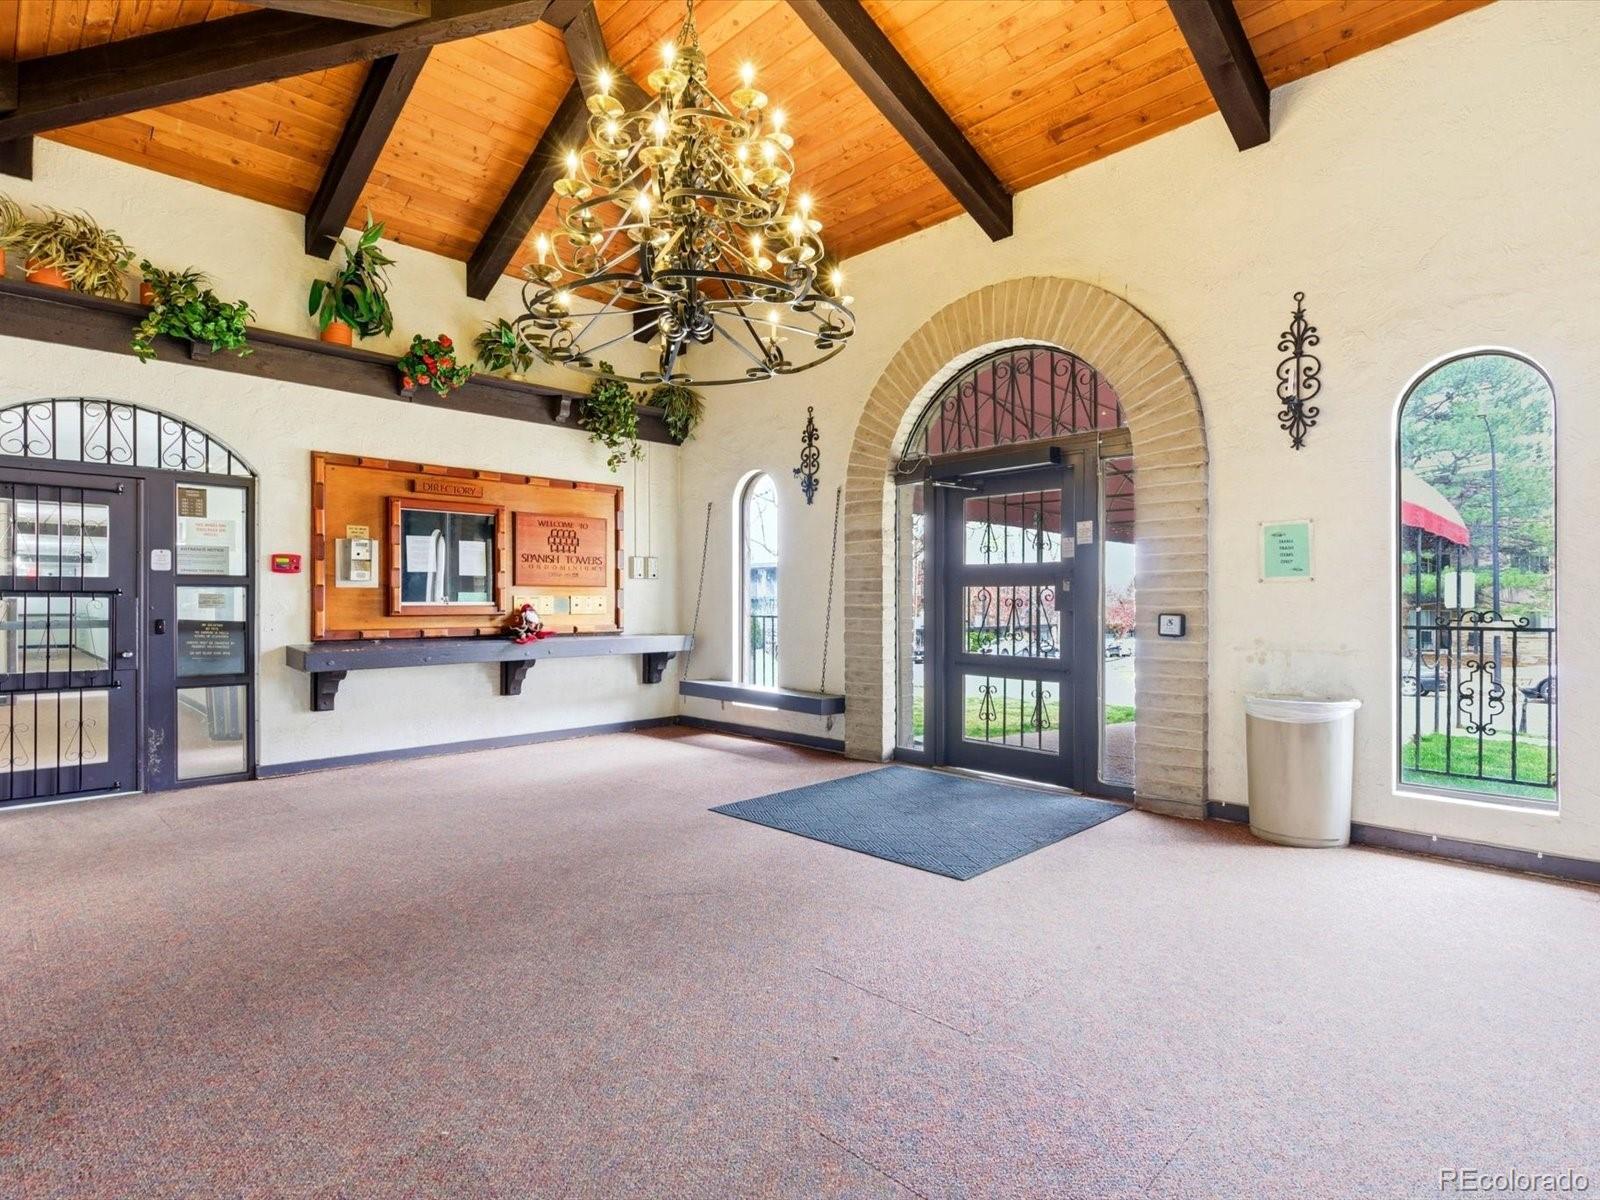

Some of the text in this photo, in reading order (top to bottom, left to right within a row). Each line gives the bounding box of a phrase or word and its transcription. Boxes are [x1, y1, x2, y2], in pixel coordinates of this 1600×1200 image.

[422, 482, 476, 496] DIRECTORY
[537, 520, 574, 529] WELCOME
[521, 553, 603, 566] SPANISH TOWERS
